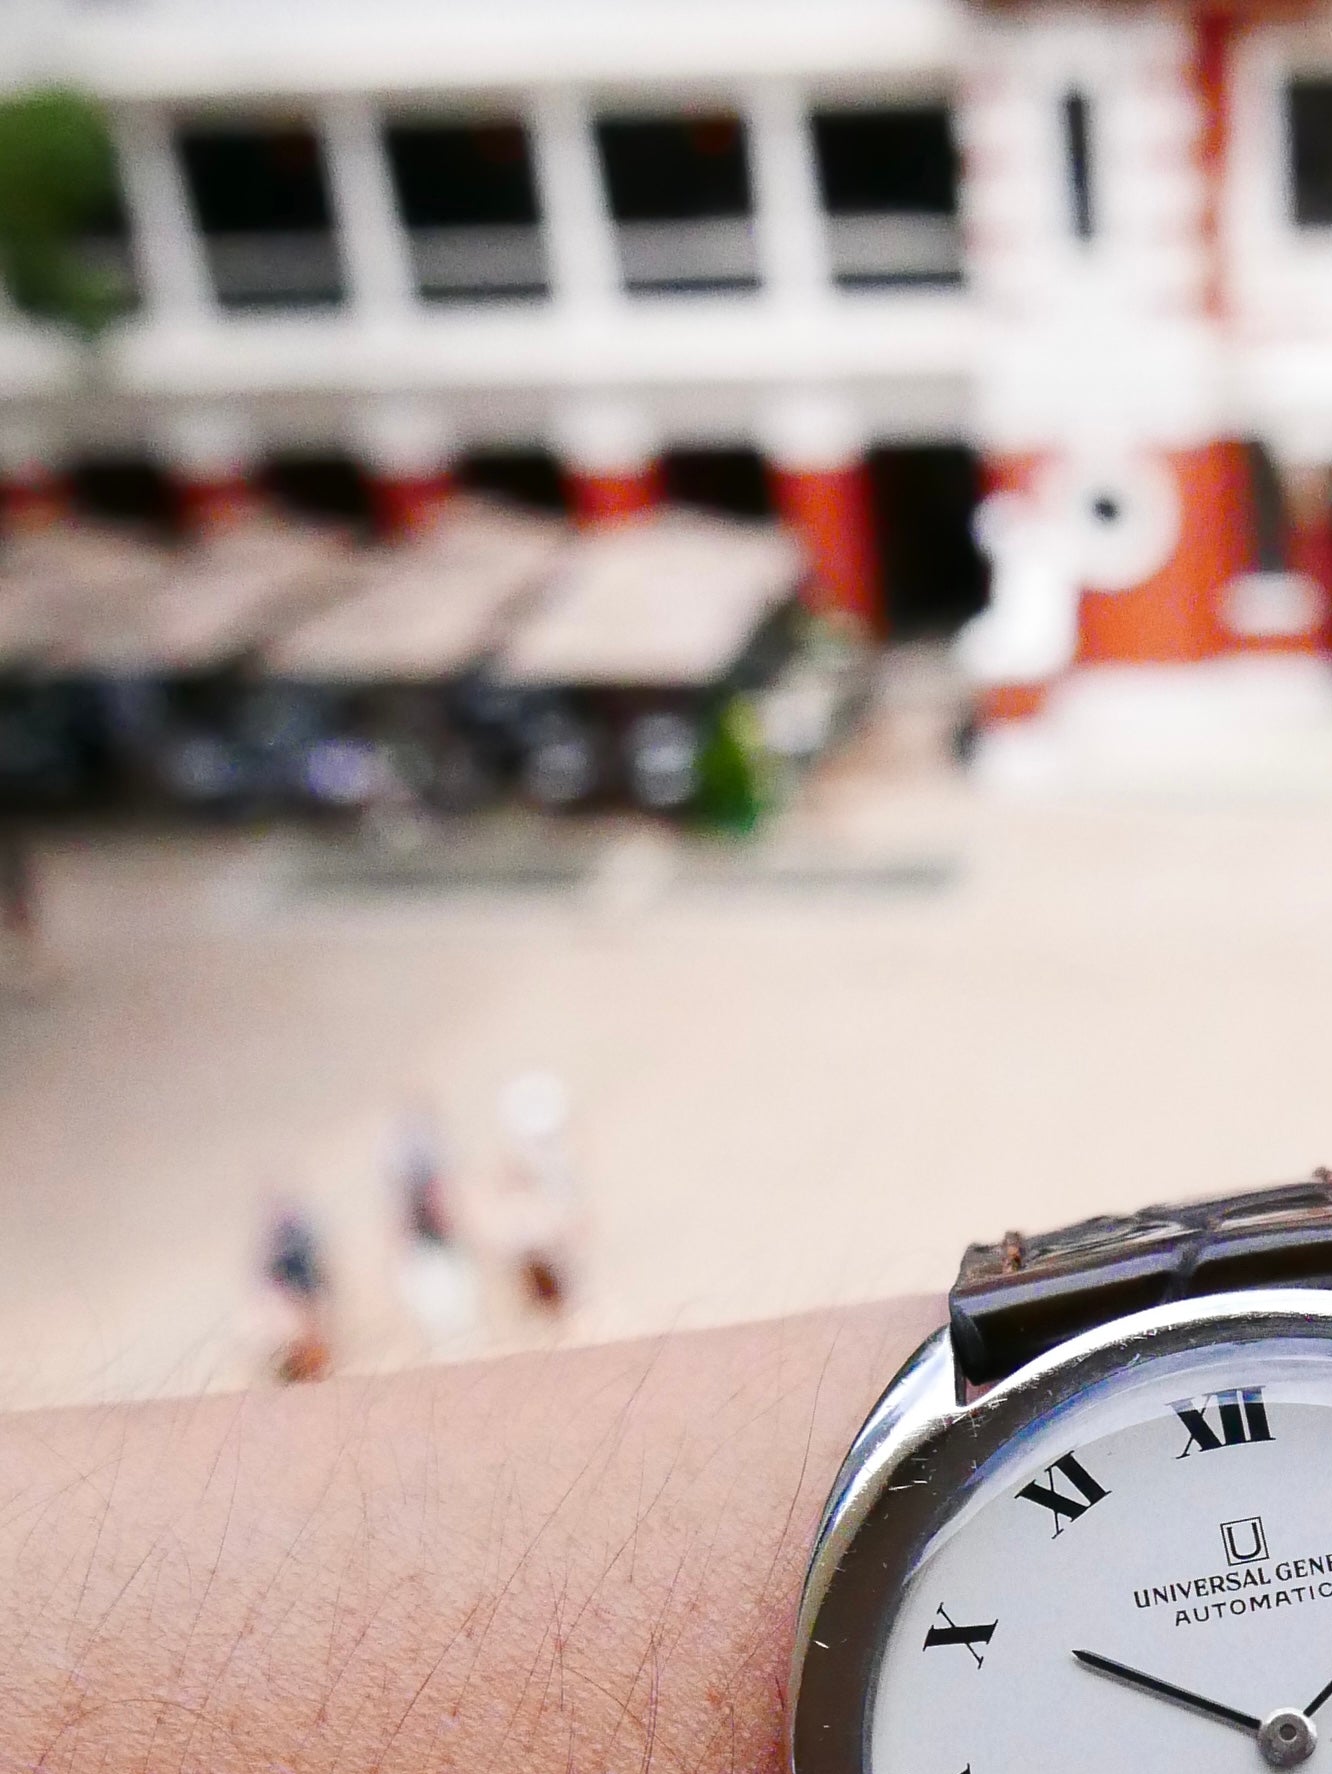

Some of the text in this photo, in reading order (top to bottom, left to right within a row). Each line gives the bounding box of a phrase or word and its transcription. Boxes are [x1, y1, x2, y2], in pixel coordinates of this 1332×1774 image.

[1165, 1385, 1276, 1459] XII
[1014, 1450, 1111, 1539] XI
[1226, 1522, 1263, 1560] U
[1132, 1567, 1272, 1609] UNIVERSAL
[922, 1602, 999, 1669] X
